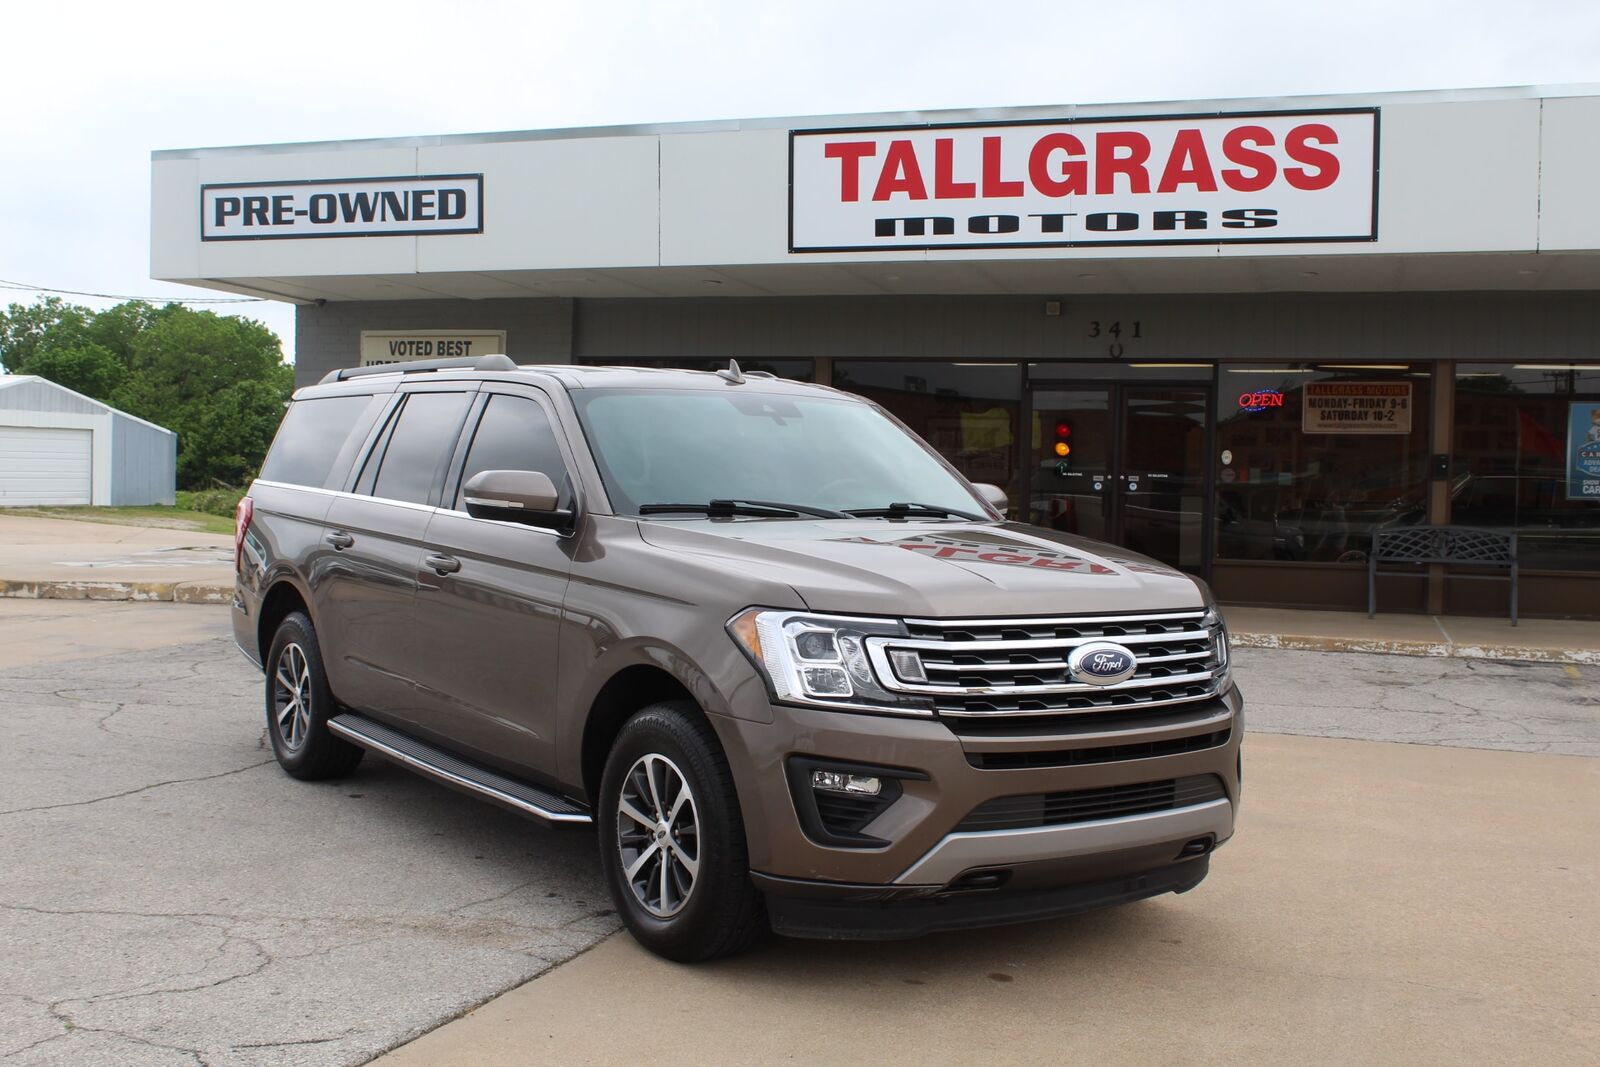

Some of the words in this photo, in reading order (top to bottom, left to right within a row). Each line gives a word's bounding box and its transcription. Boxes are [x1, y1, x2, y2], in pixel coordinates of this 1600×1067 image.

[824, 123, 1341, 203] TALLGRASS
[214, 188, 467, 227] PRE-OWNED
[874, 208, 1279, 237] MOTORS
[389, 340, 433, 356] VOTED
[437, 340, 473, 356] BEST
[1238, 392, 1285, 407] OPEN
[1308, 398, 1387, 409] MONDAY-FRIDAY
[1320, 410, 1368, 421] SATURDAY
[1373, 410, 1395, 421] 10-2
[1092, 653, 1124, 672] Ford
